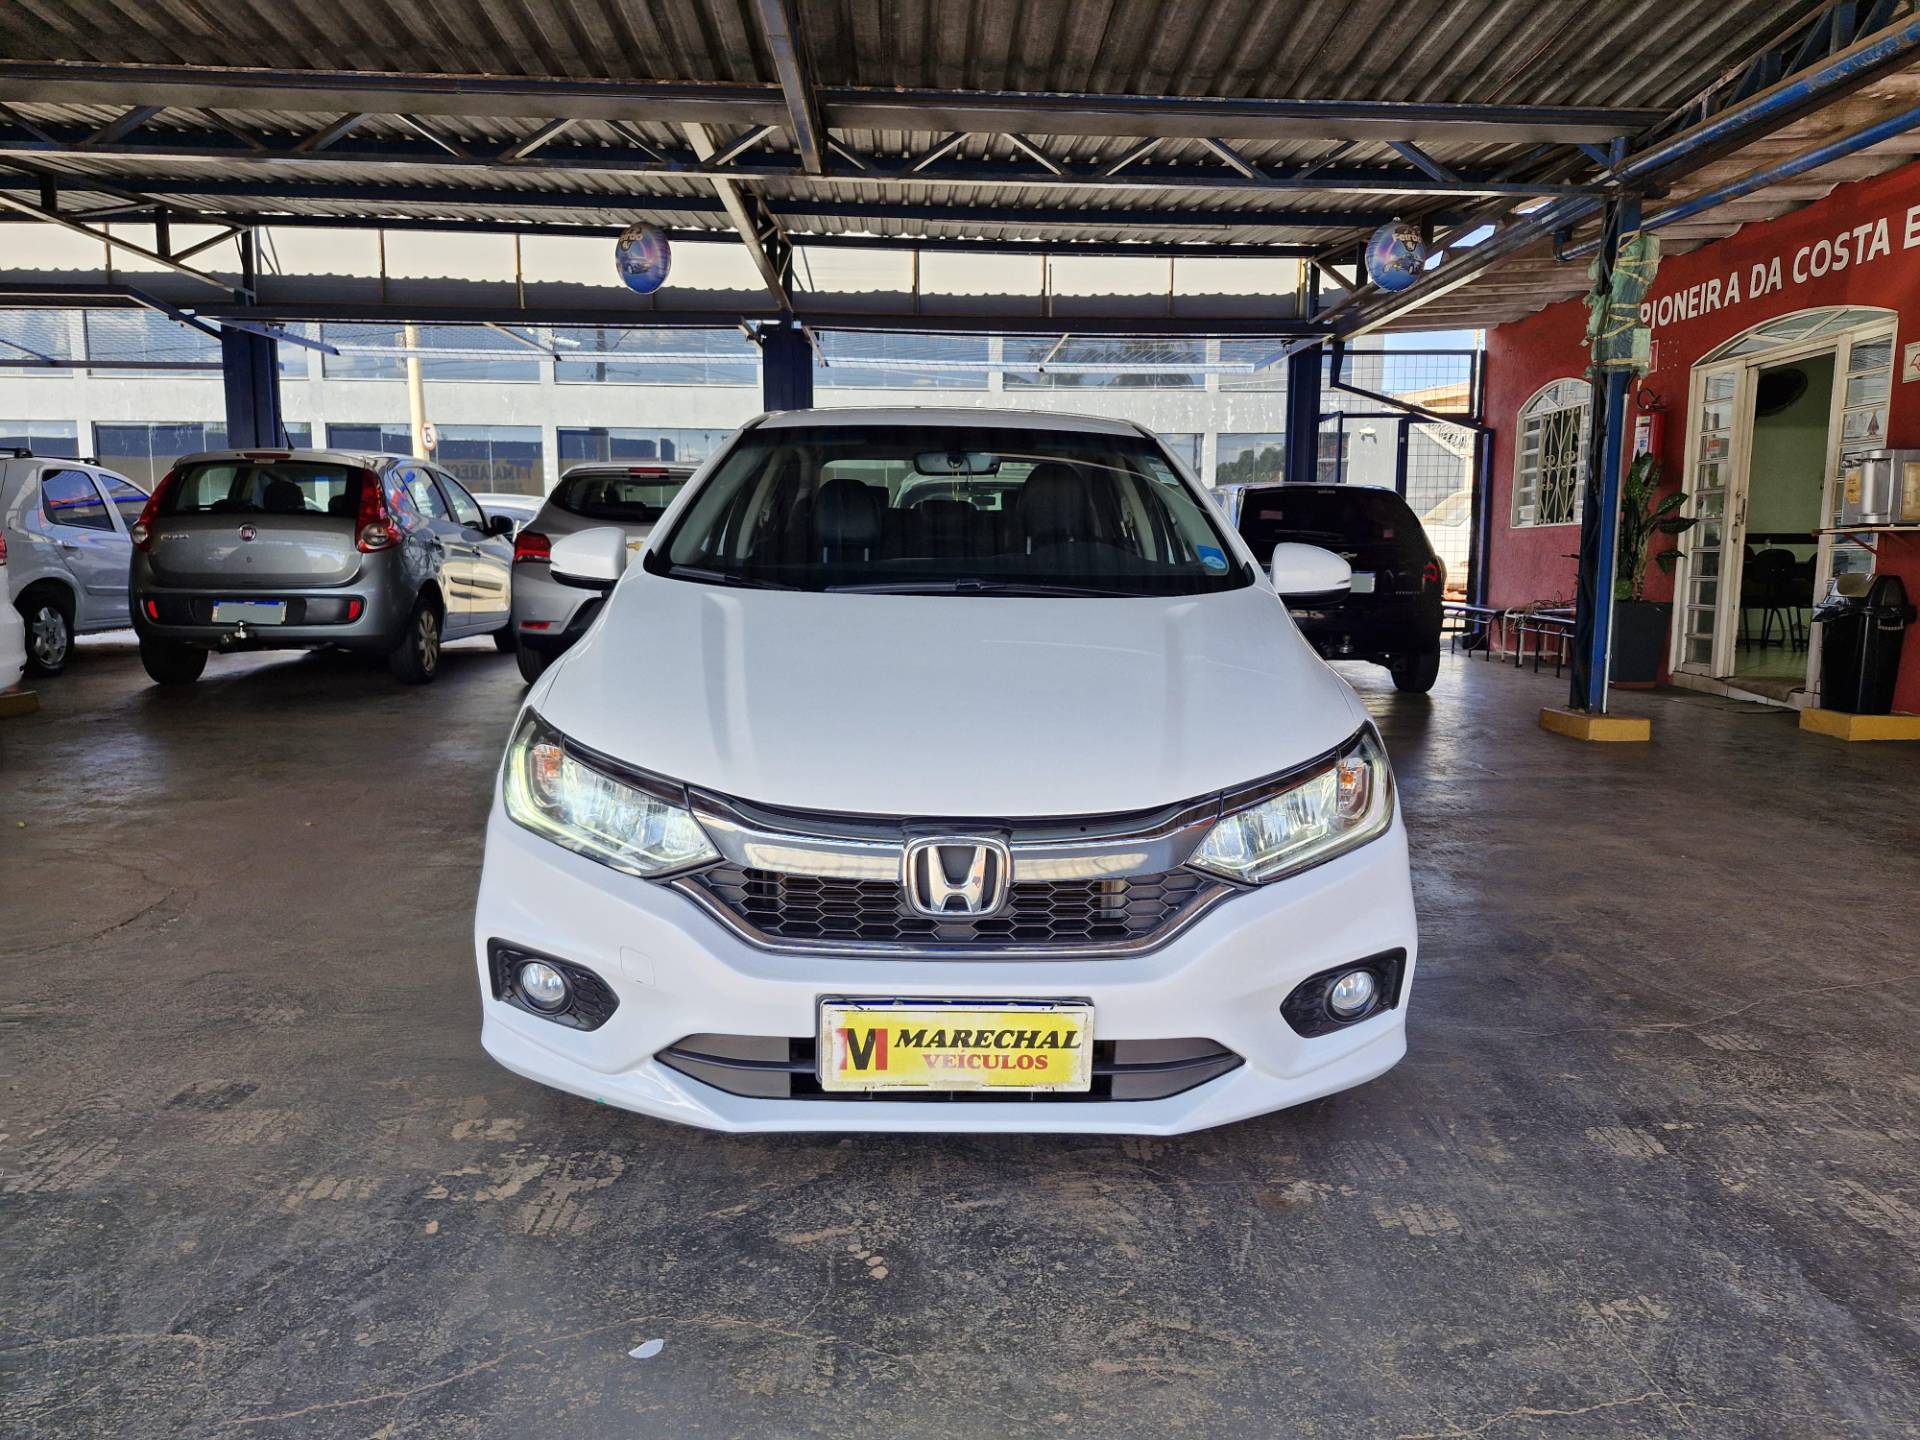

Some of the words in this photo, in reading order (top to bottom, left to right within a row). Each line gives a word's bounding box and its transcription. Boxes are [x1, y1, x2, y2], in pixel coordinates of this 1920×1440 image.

[1749, 256, 1783, 299] DA
[1792, 217, 1891, 284] COSTA
[894, 1029, 1082, 1050] MARECHAL
[922, 1048, 1048, 1070] VEÍCULOS
